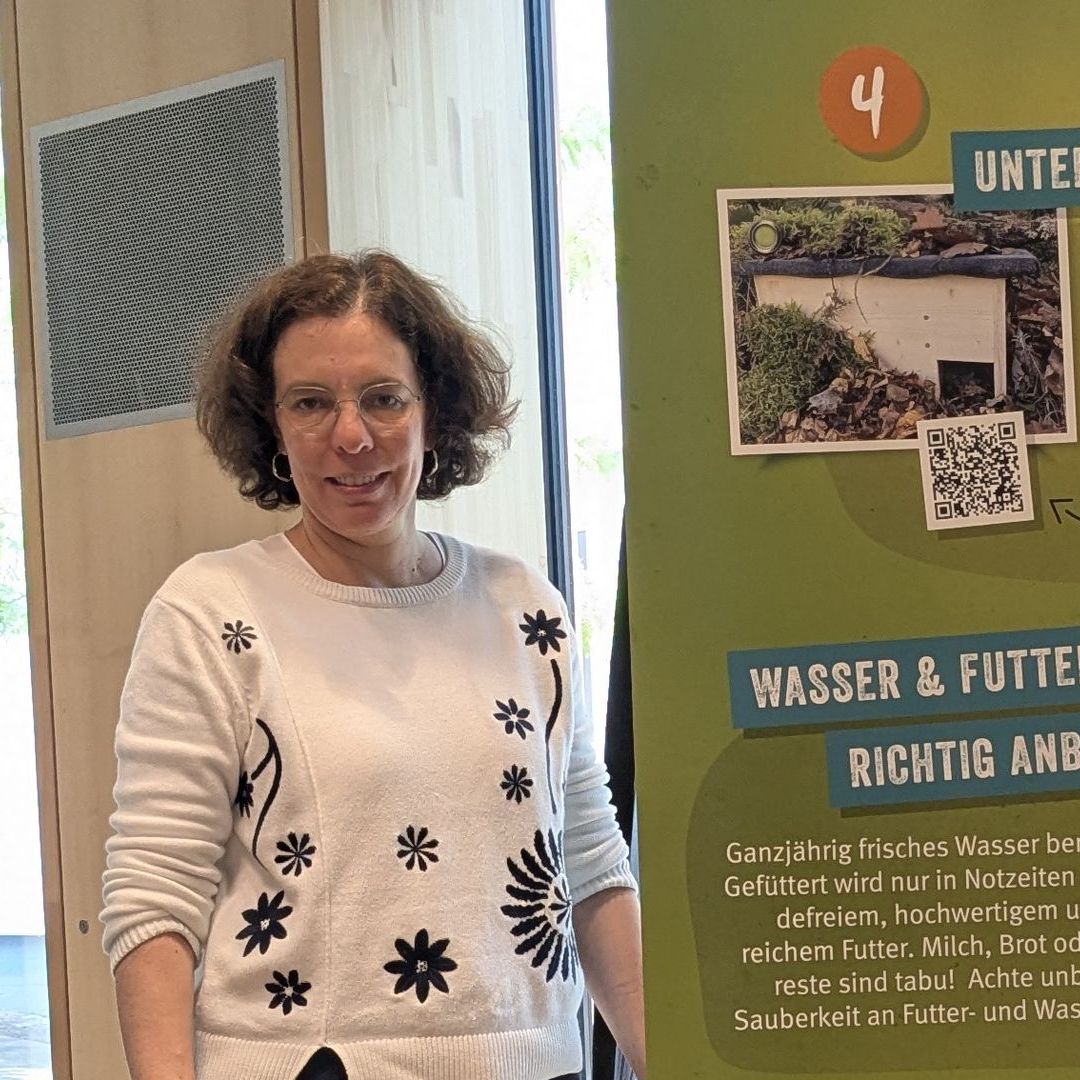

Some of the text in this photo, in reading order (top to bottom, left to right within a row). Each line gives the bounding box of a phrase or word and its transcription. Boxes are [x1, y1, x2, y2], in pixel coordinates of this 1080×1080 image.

[851, 66, 884, 139] 4
[749, 659, 901, 708] WASSER
[916, 656, 945, 697] &
[849, 737, 995, 788] RICHTIG
[726, 838, 853, 867] Ganzjährig
[858, 835, 949, 860] frisches
[954, 835, 1040, 856] Wasser
[724, 874, 829, 897] Gefüttert
[833, 870, 883, 894] wird
[891, 875, 930, 892] nur
[936, 869, 956, 890] in
[965, 866, 1074, 889] Notzeiten
[777, 905, 887, 929] defreiem,
[895, 900, 1057, 926] hochwertigem
